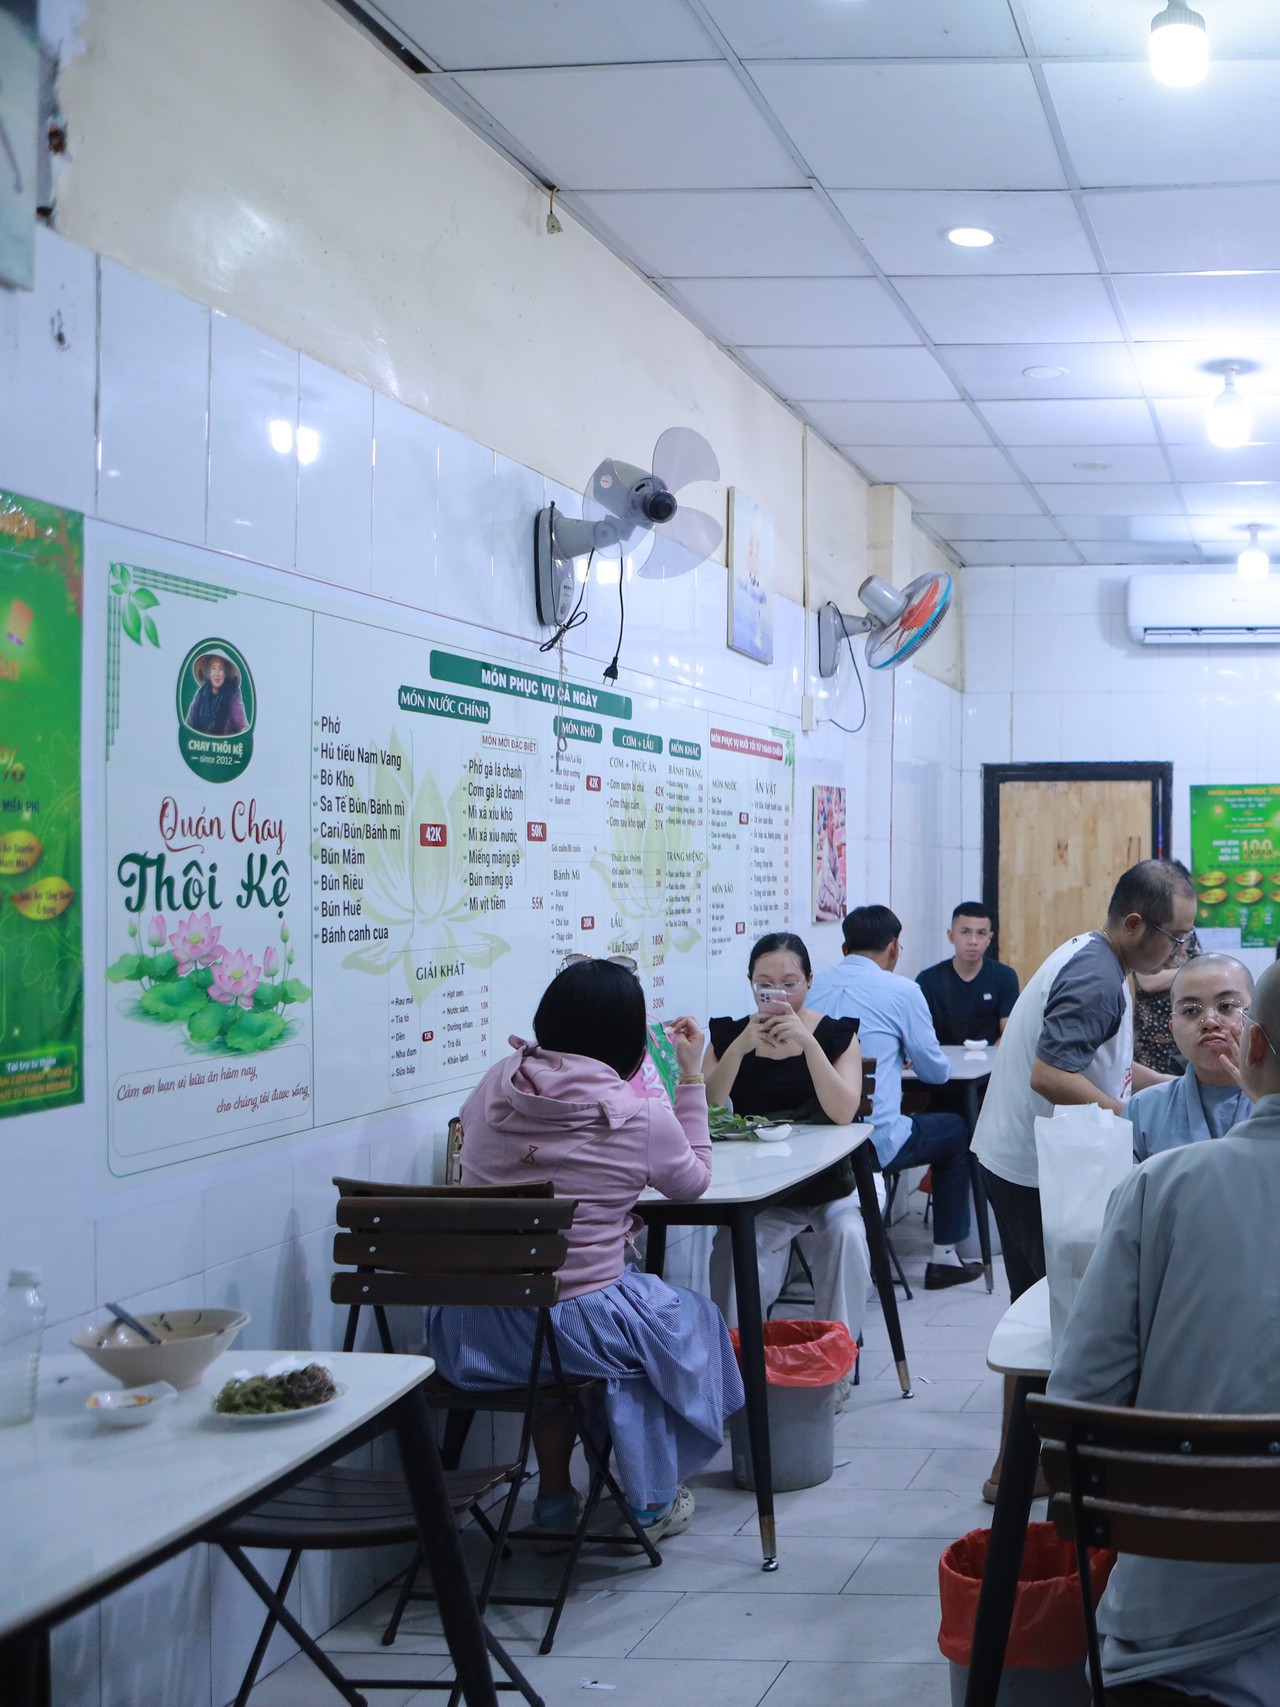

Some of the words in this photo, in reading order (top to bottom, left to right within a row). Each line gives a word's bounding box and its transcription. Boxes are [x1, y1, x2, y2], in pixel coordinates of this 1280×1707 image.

[481, 667, 507, 689] MÓN
[509, 675, 539, 697] PHỤC
[541, 682, 555, 702] VỤ
[557, 683, 571, 703] CẢ
[572, 690, 598, 708] NGÀY
[400, 689, 426, 708] MÓN
[428, 694, 456, 714] NƯỚC
[457, 701, 489, 720] CHÍNH
[321, 716, 341, 734] Phở
[562, 720, 579, 735] MÓN
[580, 723, 595, 738] KHÔ
[188, 739, 211, 752] CHAY
[211, 741, 232, 755] THÔI
[232, 742, 244, 758] KỆ
[321, 742, 334, 760] Hủ
[337, 743, 355, 762] tiếu
[357, 747, 378, 764] Nam
[380, 749, 402, 771] Vang
[671, 741, 685, 755] MÓN
[685, 743, 699, 757] KHÁC
[200, 754, 216, 764] since
[215, 755, 233, 765] 2012
[468, 758, 483, 775] Phở
[484, 762, 493, 779] gà
[494, 762, 501, 777] lá
[502, 763, 522, 779] chanh
[320, 769, 333, 786] Bò
[336, 770, 354, 788] Kho
[669, 764, 685, 776] BÁNH
[468, 782, 484, 797] Cơm
[485, 784, 495, 801] gà
[496, 784, 503, 799] lá
[503, 785, 524, 800] chanh
[589, 777, 599, 789] 42K
[320, 795, 333, 812] Sa
[335, 794, 348, 813] Tế
[349, 798, 393, 816] Bún/Bánh
[394, 800, 405, 816] mì
[159, 796, 225, 854] Quán
[231, 798, 286, 855] Chay
[390, 824, 401, 840] mì
[425, 826, 442, 842] 42K
[531, 824, 543, 838] 50K
[321, 848, 340, 865] Bún
[342, 846, 365, 865] Mắm
[491, 849, 511, 867] măng
[512, 850, 520, 868] gà
[321, 874, 340, 891] Bún
[342, 873, 364, 891] Riêu
[469, 871, 483, 886] Bún
[484, 871, 504, 889] măng
[505, 875, 513, 889] gà
[553, 868, 570, 881] Bánh
[571, 870, 580, 881] Mì
[118, 851, 223, 913] Thôi
[236, 852, 291, 919] Kệ
[321, 900, 340, 917] Bún
[343, 897, 363, 916] Huế
[469, 897, 479, 911] Mì
[480, 897, 489, 914] vịt
[531, 896, 544, 910] 55K
[321, 925, 346, 944] Bánh
[348, 924, 371, 942] canh
[372, 927, 389, 940] cua
[416, 961, 437, 981] GIẢI
[440, 960, 465, 978] KHÁT
[652, 955, 665, 967] 230K
[652, 975, 665, 988] 280K
[652, 998, 665, 1010] 330K
[117, 1084, 140, 1101] Cảm
[142, 1083, 155, 1096] ơn
[157, 1078, 176, 1094] bạn
[189, 1073, 205, 1087] bữa
[207, 1070, 218, 1083] ăn
[221, 1067, 239, 1080] hôm
[240, 1065, 258, 1082] nay
[216, 1098, 232, 1114] cho
[233, 1093, 259, 1113] chúng
[259, 1092, 270, 1106] tôi
[271, 1087, 290, 1102] được
[291, 1082, 309, 1101] sống
